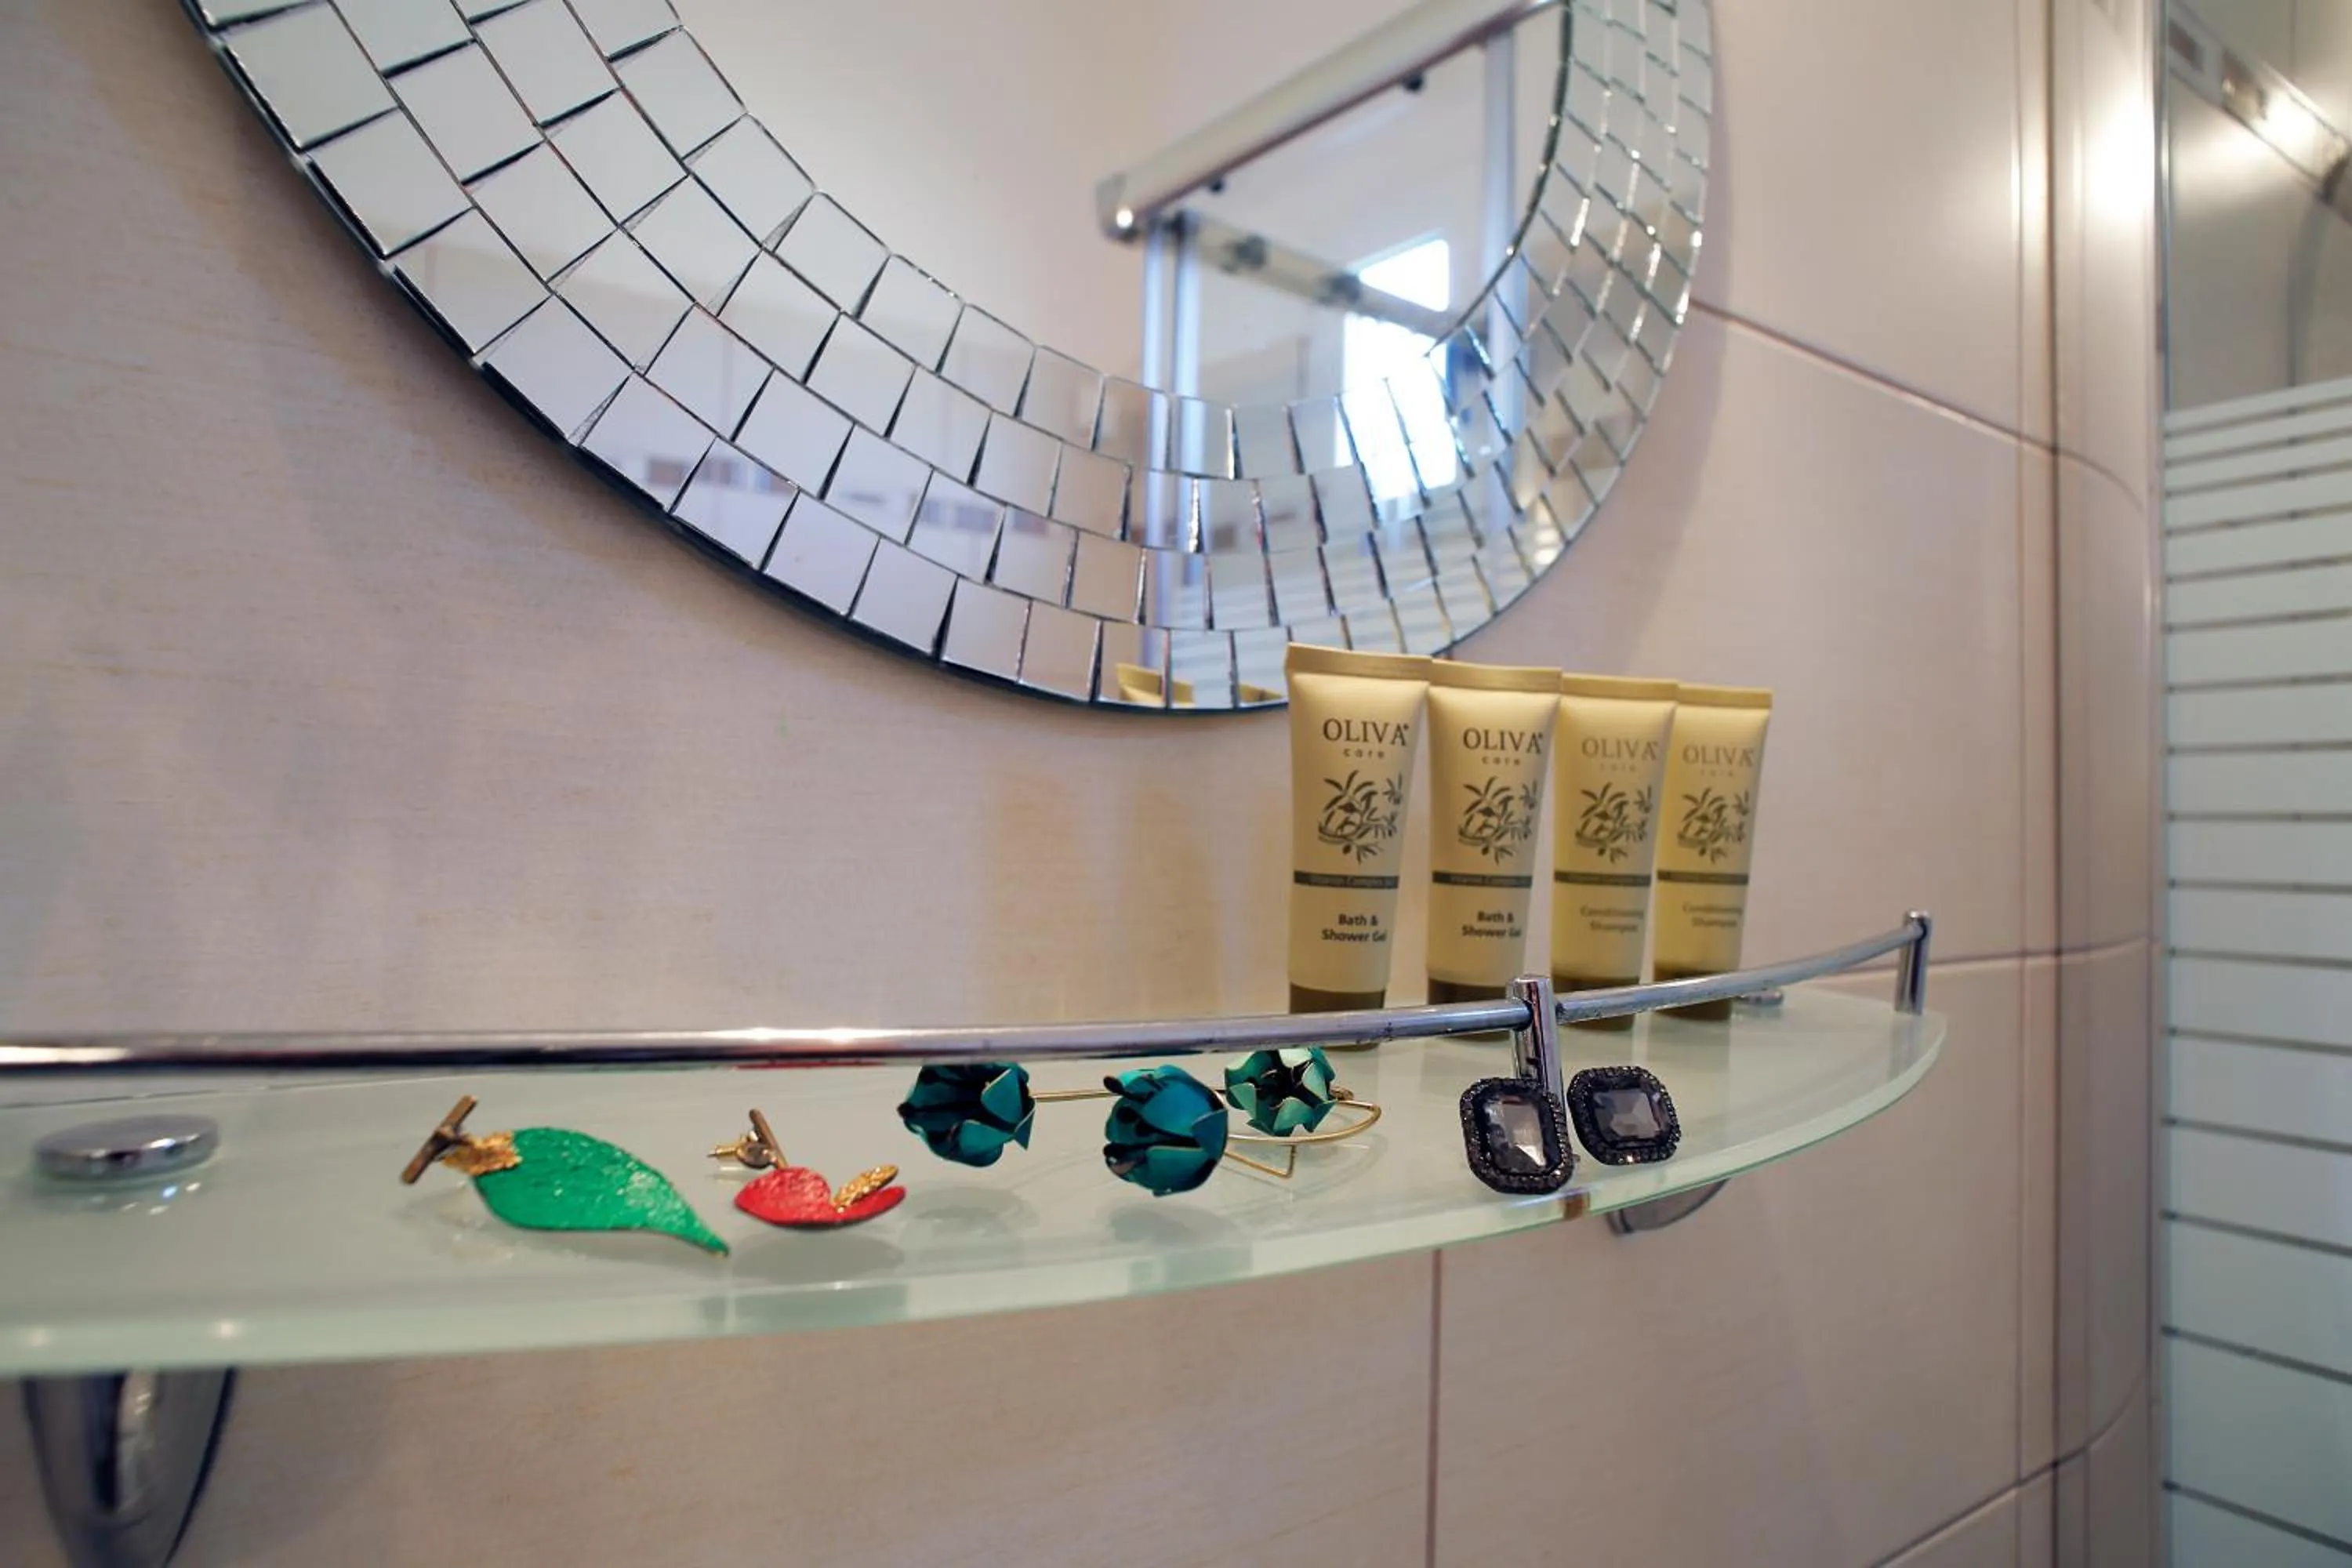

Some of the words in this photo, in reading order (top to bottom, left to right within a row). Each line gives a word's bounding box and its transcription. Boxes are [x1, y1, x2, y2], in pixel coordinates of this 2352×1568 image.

[1323, 718, 1407, 746] OLIVA
[1463, 727, 1542, 754] OLIVA
[1581, 738, 1658, 761] OLIVA
[1682, 743, 1754, 768] OLIVA
[1338, 913, 1367, 926] Bath
[1477, 911, 1504, 923] Bath
[1322, 928, 1370, 942] Shower
[1462, 924, 1507, 937] Shower
